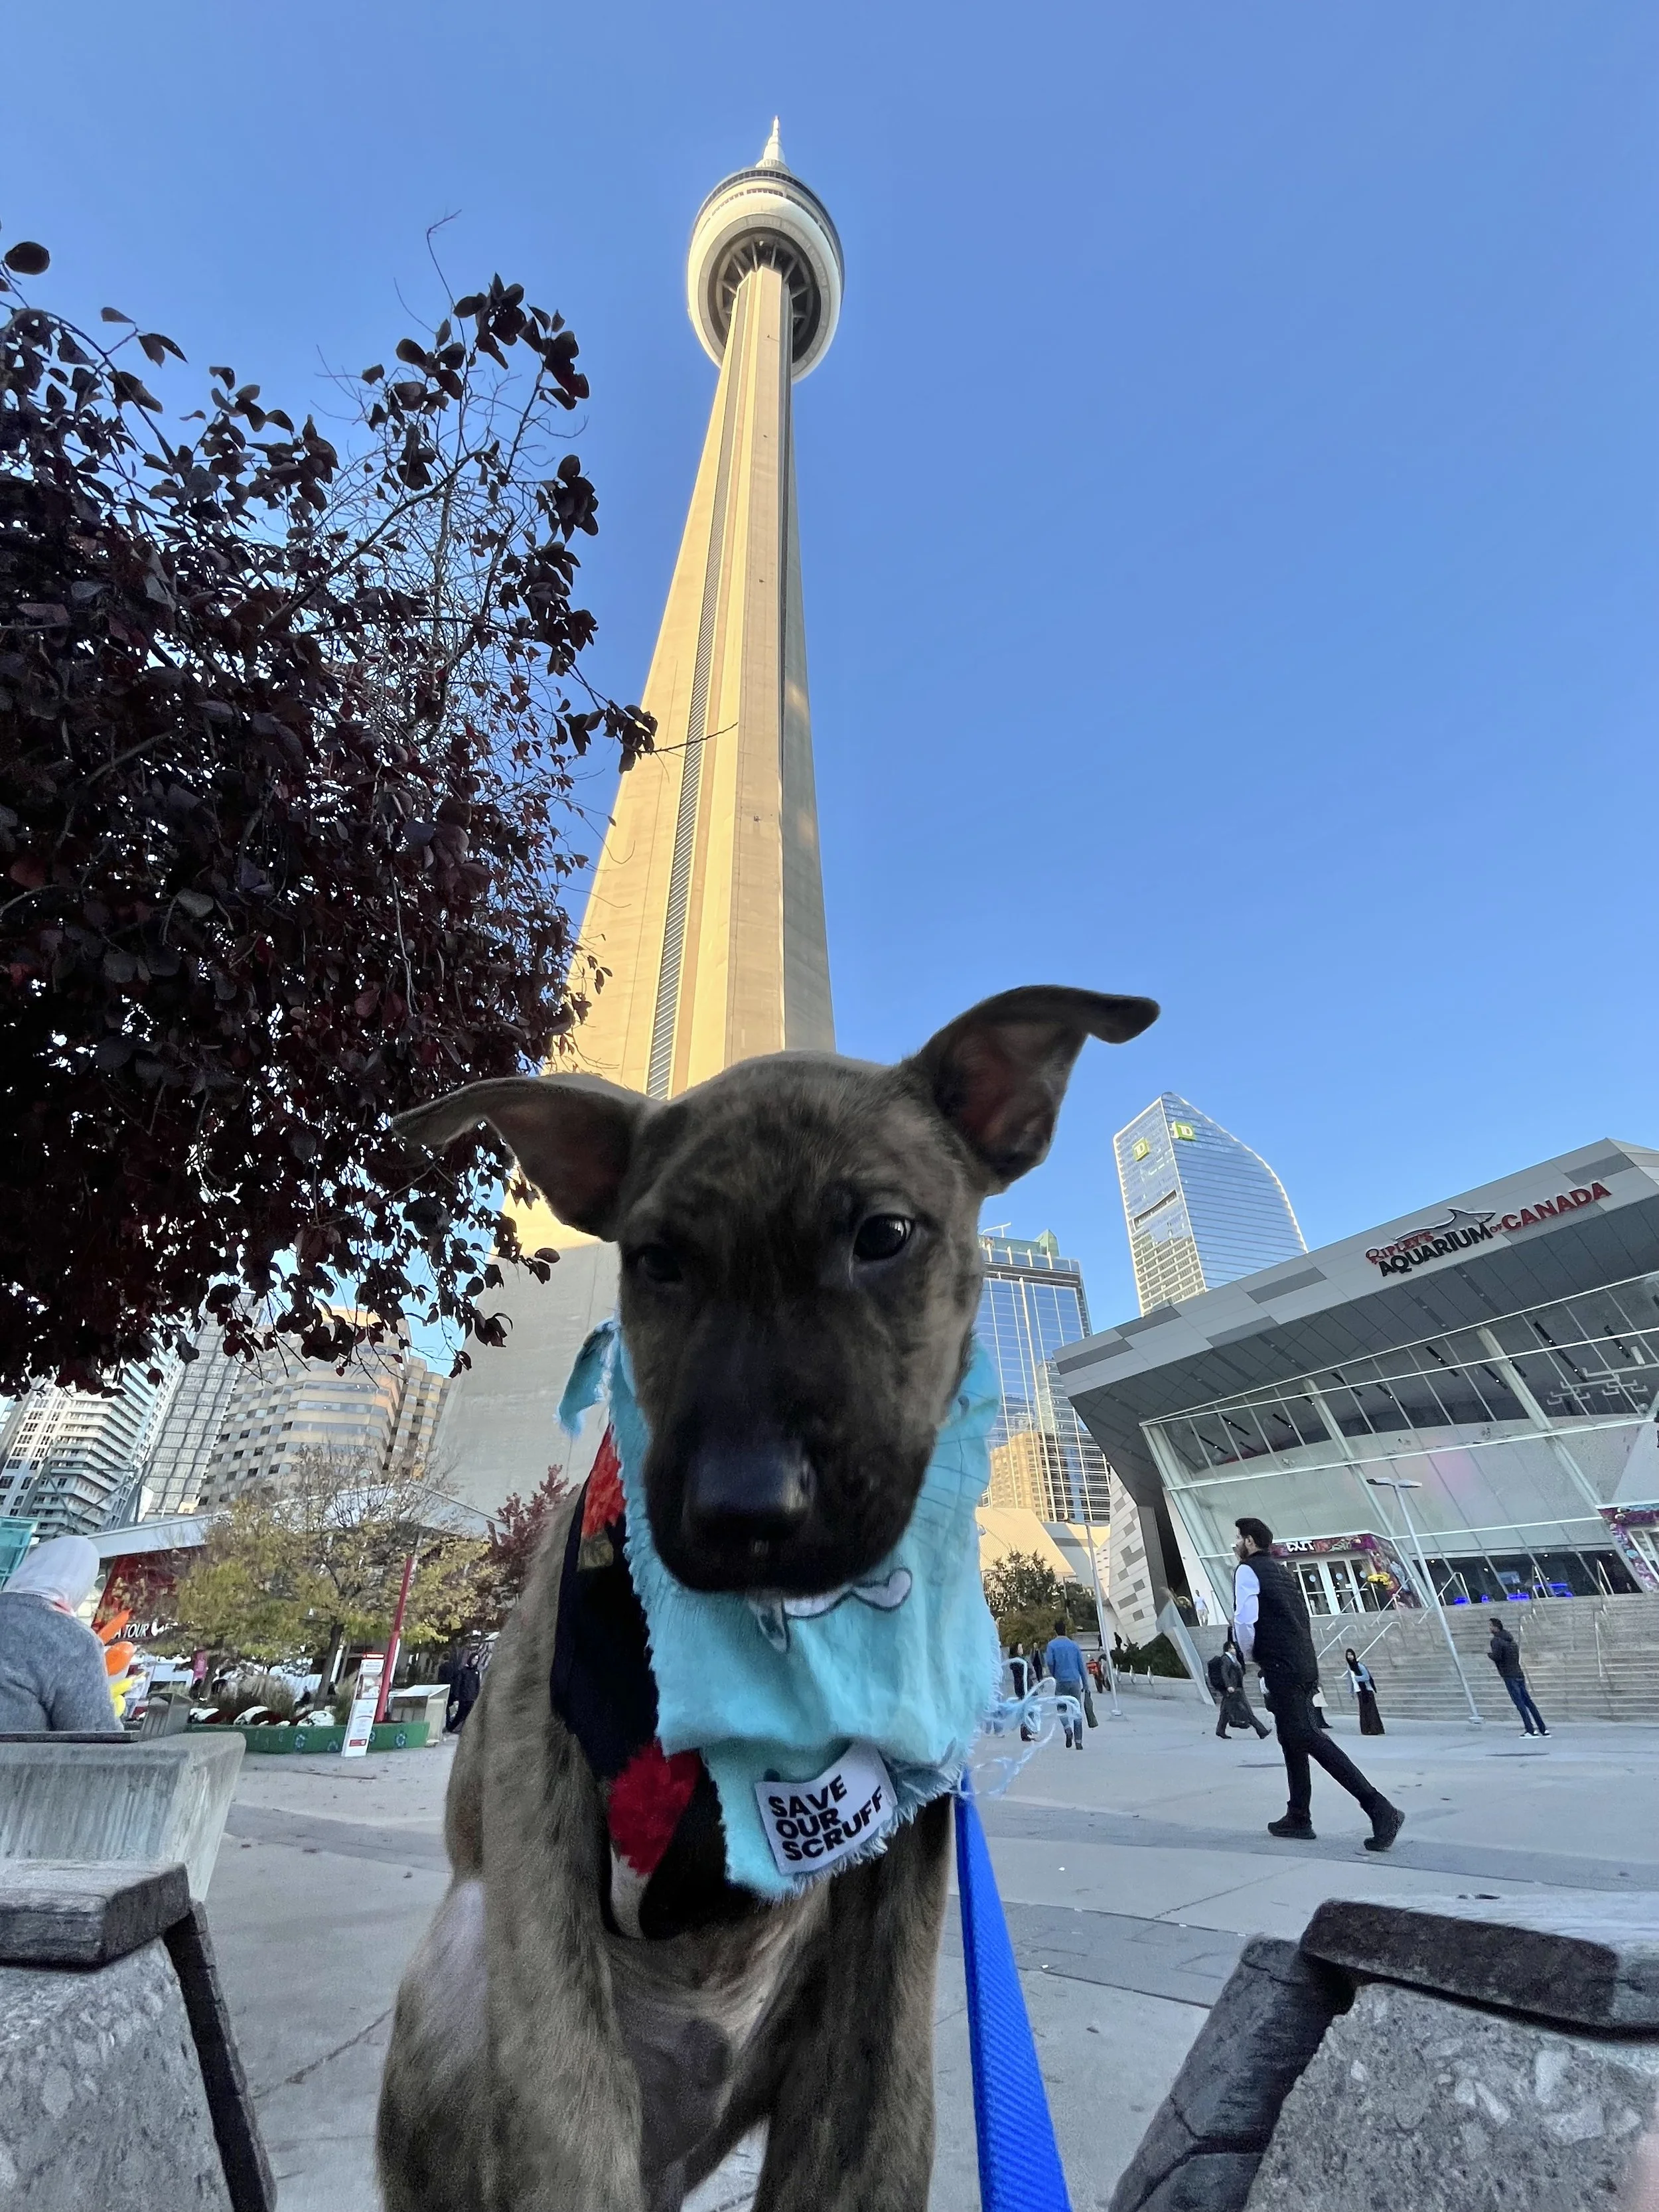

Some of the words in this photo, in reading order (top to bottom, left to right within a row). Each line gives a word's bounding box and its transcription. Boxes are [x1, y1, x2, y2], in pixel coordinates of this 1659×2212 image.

[1133, 1142, 1146, 1157] TD
[1378, 1222, 1494, 1277] AQUARIUM
[1489, 1223, 1502, 1233] OF
[1501, 1182, 1613, 1230] CANADA
[1285, 1540, 1315, 1552] EXIT
[123, 1623, 150, 1639] TOUR
[767, 1774, 848, 1818] SAVE
[775, 1808, 845, 1840] OUR
[781, 1785, 883, 1862] SCRUFF
